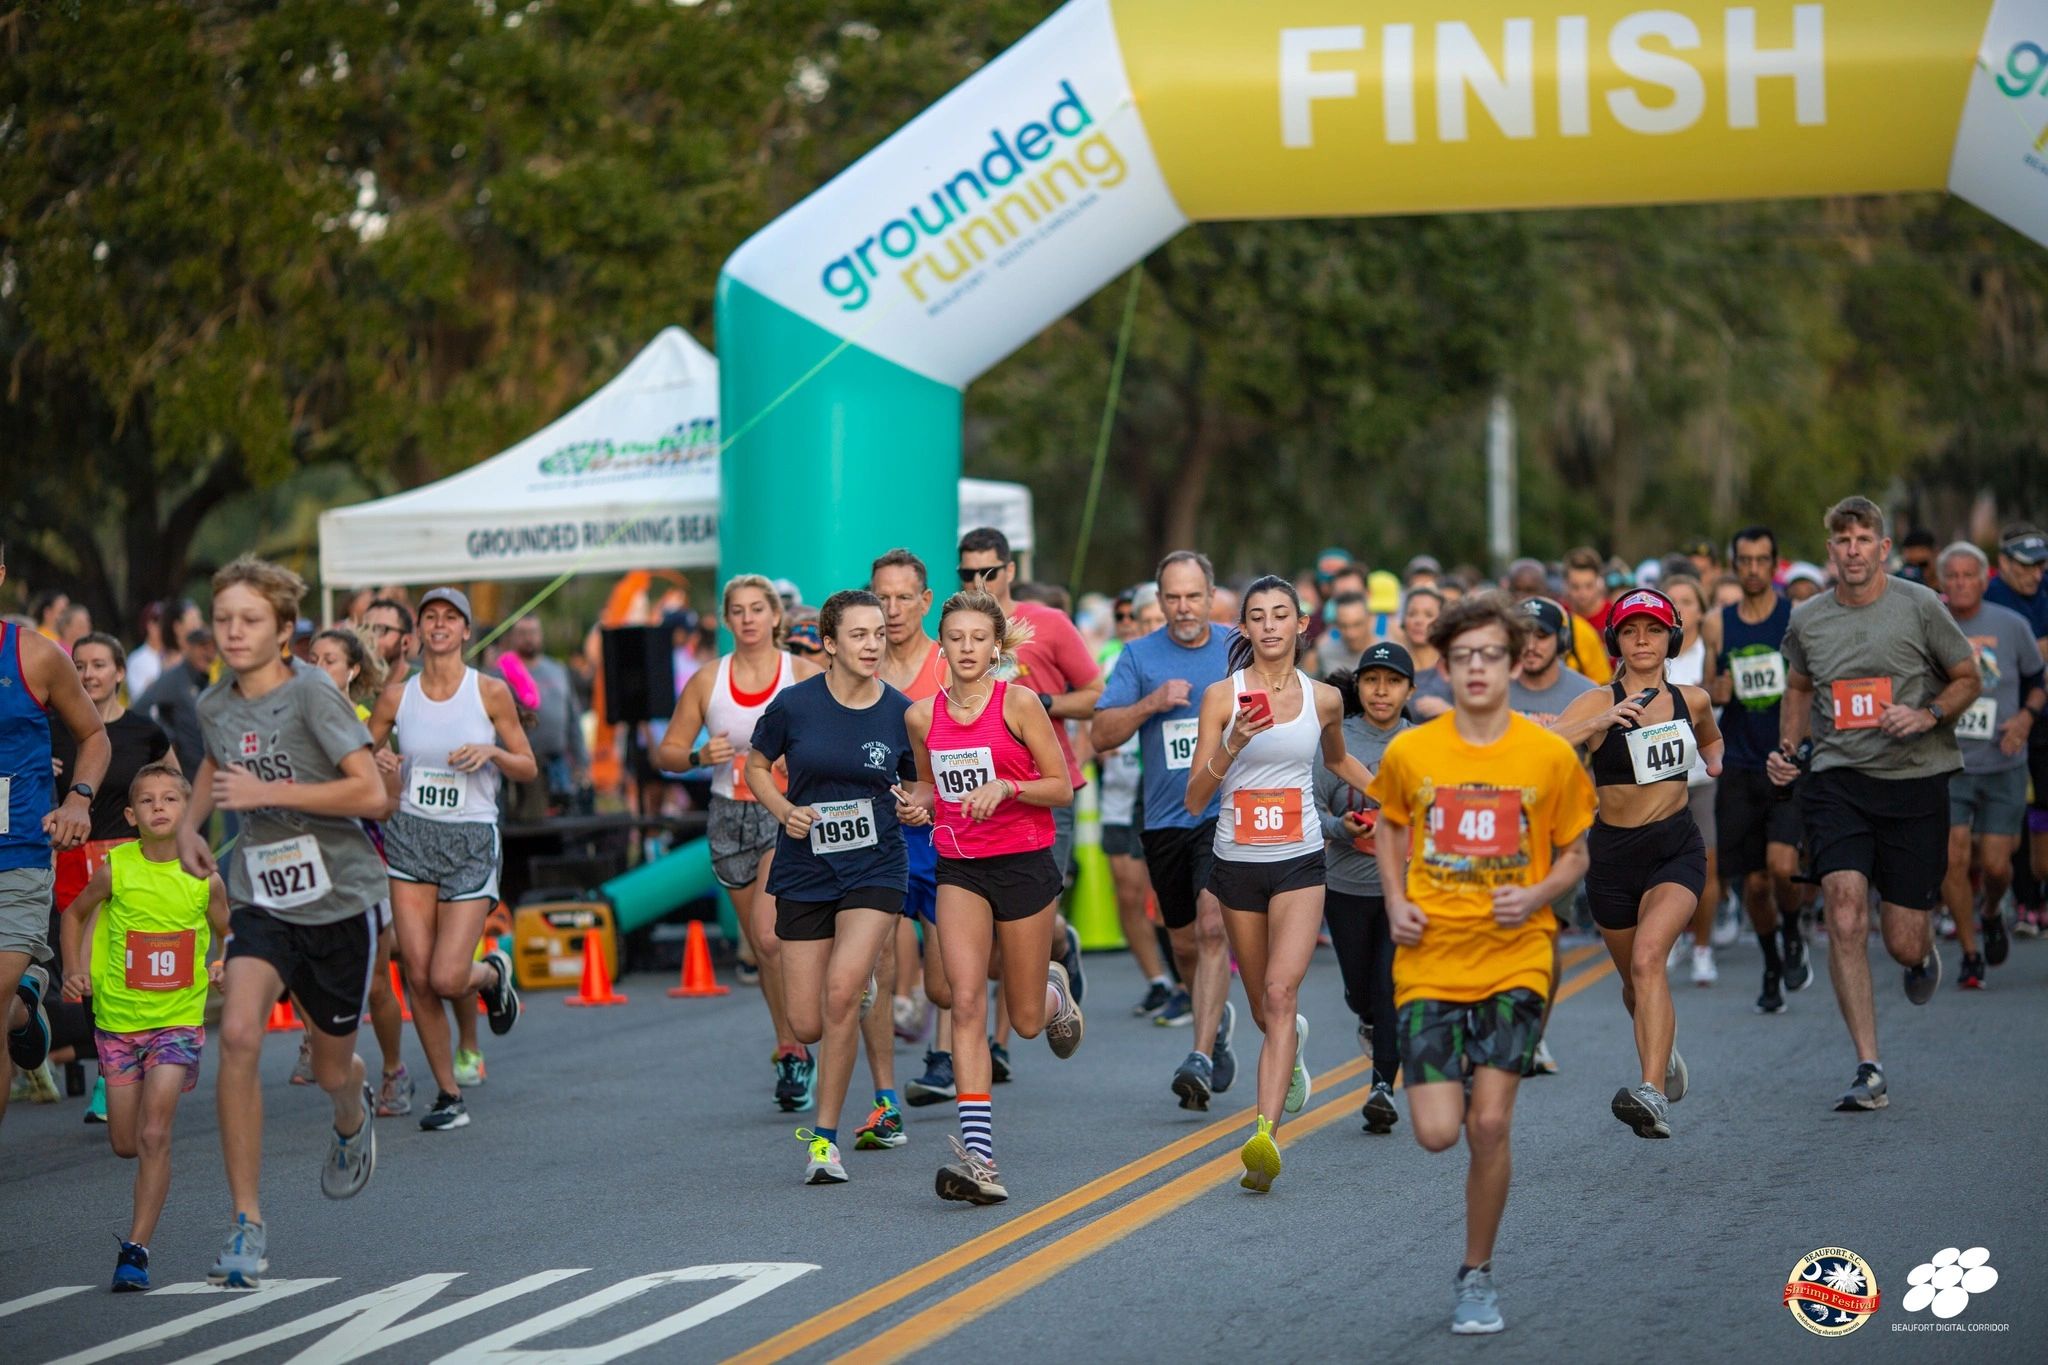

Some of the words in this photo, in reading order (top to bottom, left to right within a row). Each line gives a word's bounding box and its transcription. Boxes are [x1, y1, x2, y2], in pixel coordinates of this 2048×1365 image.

[1278, 4, 1827, 148] FINISH
[821, 78, 1093, 311] grounded
[900, 131, 1129, 303] running
[466, 522, 579, 559] GROUNDED
[582, 514, 674, 549] RUNNING
[1742, 668, 1776, 690] 902
[1851, 693, 1874, 717] 81
[1642, 722, 1677, 740] grounded
[940, 750, 978, 762] grounded
[1170, 737, 1198, 760] 19
[1647, 738, 1685, 771] 447
[949, 758, 979, 766] running
[939, 768, 988, 793] 1937
[417, 785, 459, 807] 1919
[821, 801, 859, 814] grounded
[829, 808, 860, 817] running
[1254, 805, 1284, 831] 36
[1458, 809, 1496, 841] 48
[815, 816, 870, 844] 1936
[258, 861, 316, 898] 1927
[147, 950, 176, 977] 19
